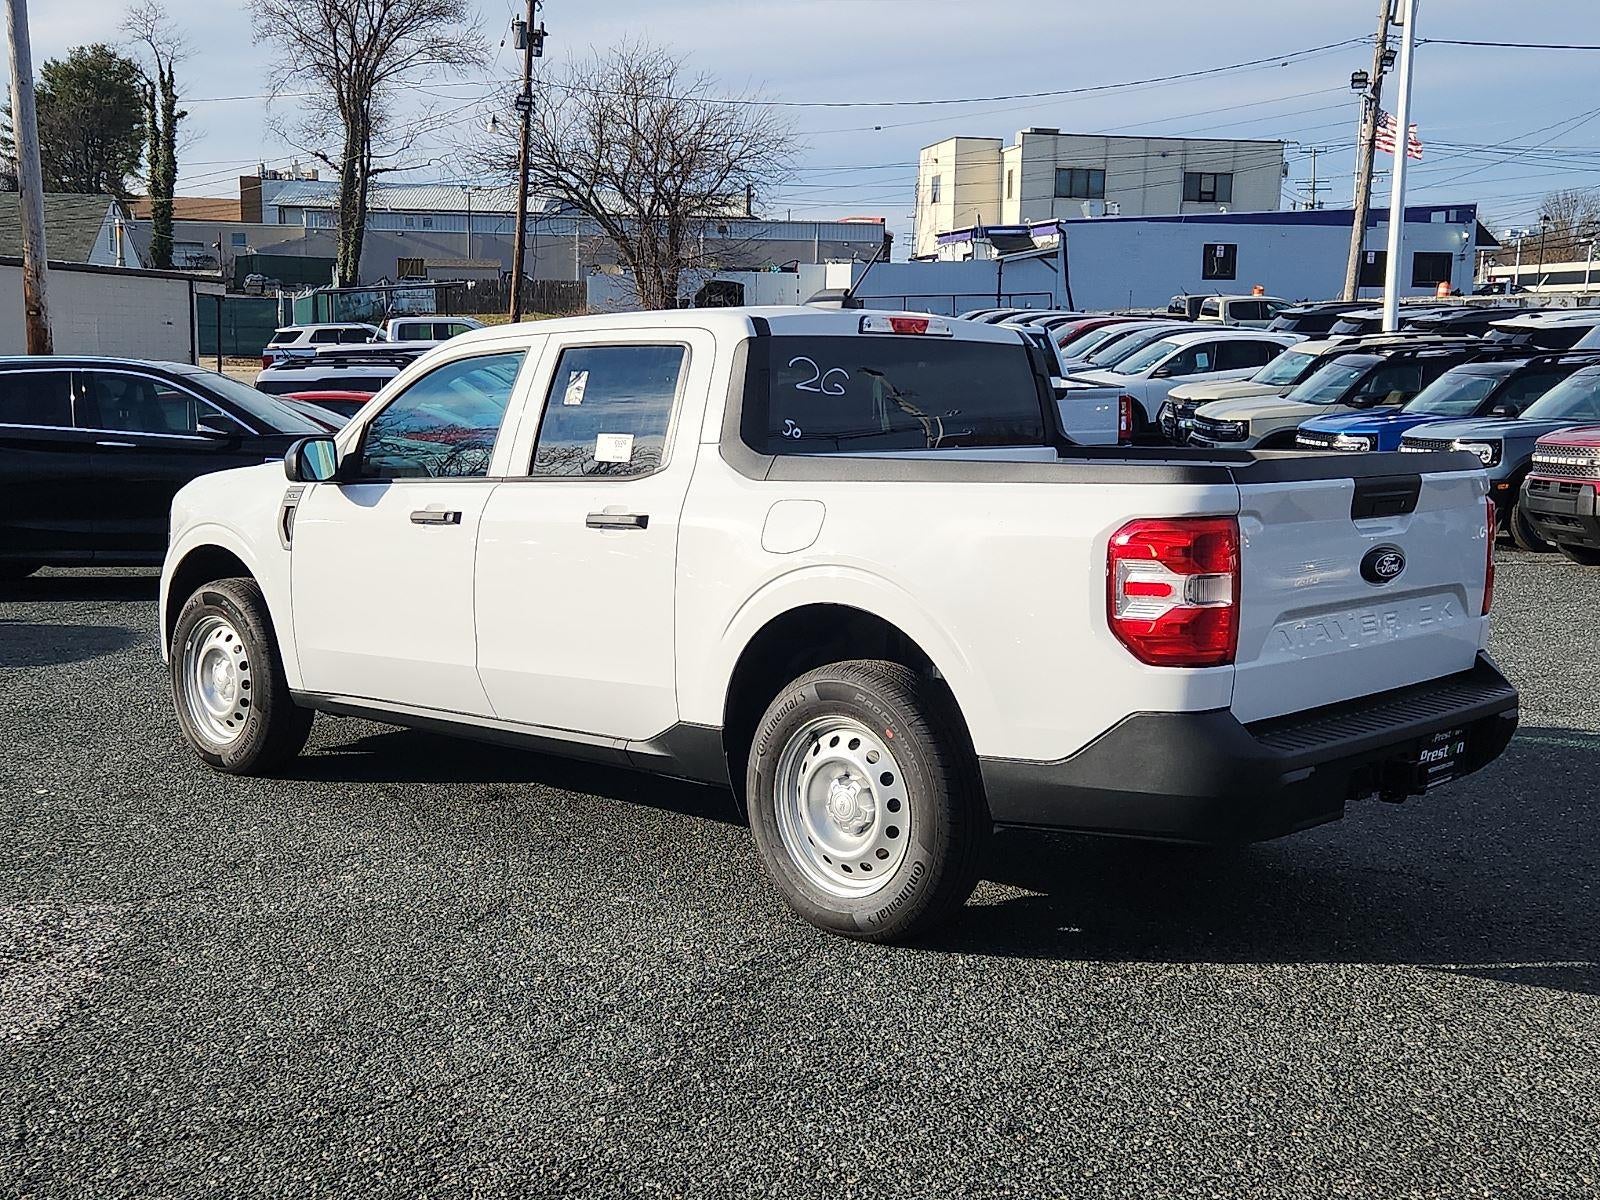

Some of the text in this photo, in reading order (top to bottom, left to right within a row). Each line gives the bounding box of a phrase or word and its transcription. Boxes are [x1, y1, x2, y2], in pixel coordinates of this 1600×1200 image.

[1380, 554, 1402, 574] Ford
[1278, 601, 1456, 651] MAVERCK
[757, 694, 799, 757] Continental
[875, 860, 926, 924] Continental
